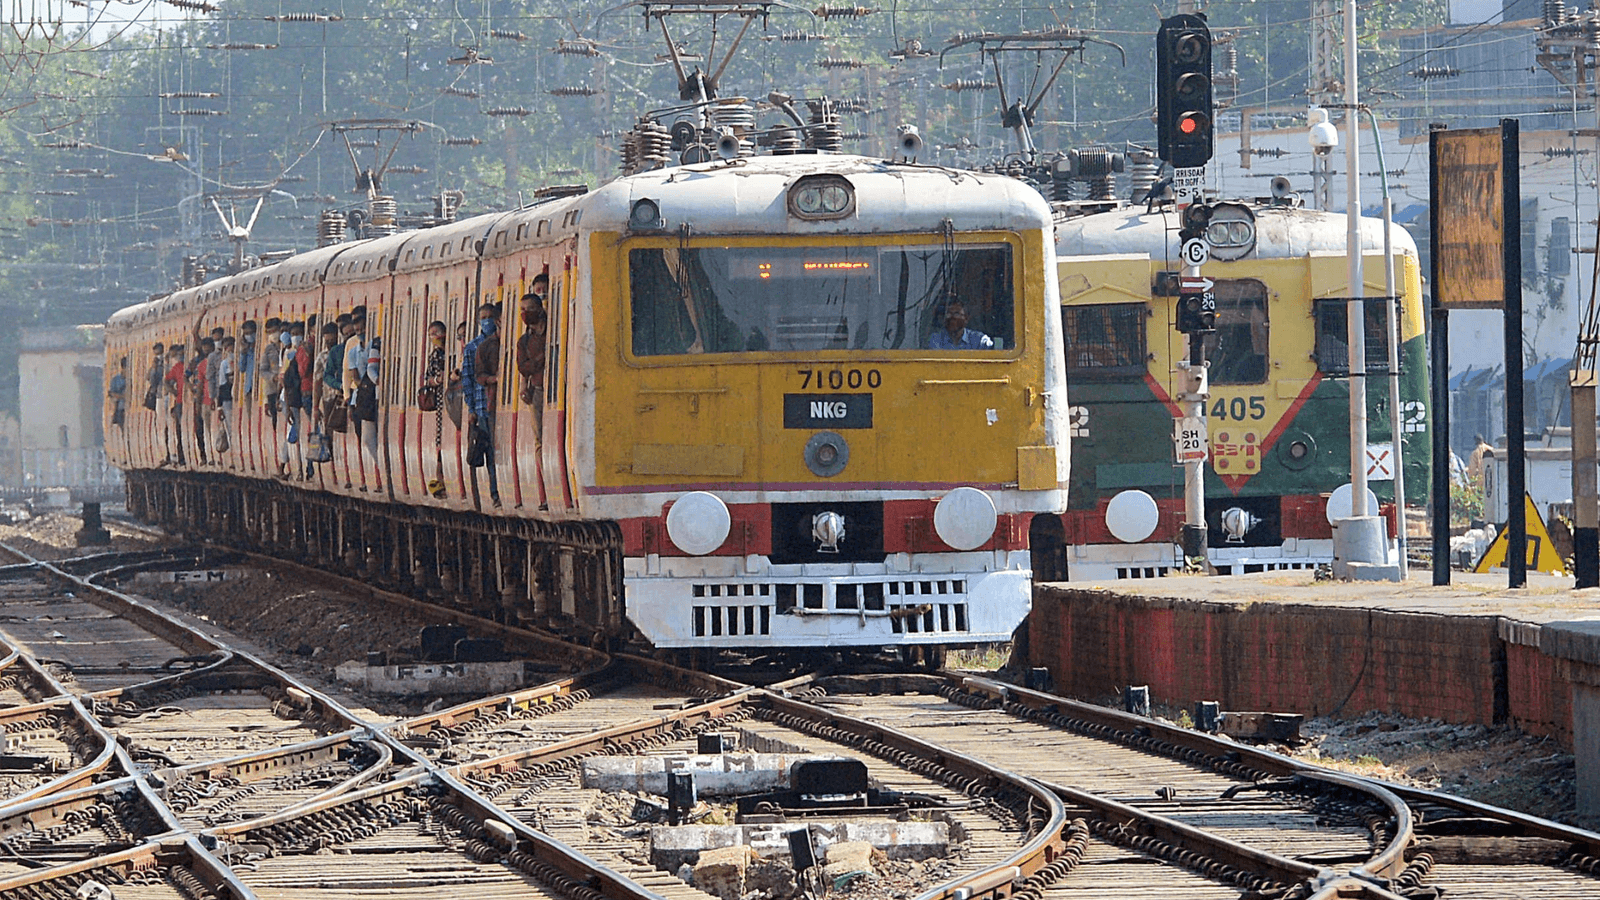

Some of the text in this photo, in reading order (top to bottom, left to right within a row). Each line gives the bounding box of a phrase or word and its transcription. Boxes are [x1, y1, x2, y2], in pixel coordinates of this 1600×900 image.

[1202, 300, 1215, 310] 20
[797, 369, 882, 390] 71000
[810, 401, 847, 419] NKG
[1182, 430, 1199, 439] SH
[1183, 439, 1199, 449] 20
